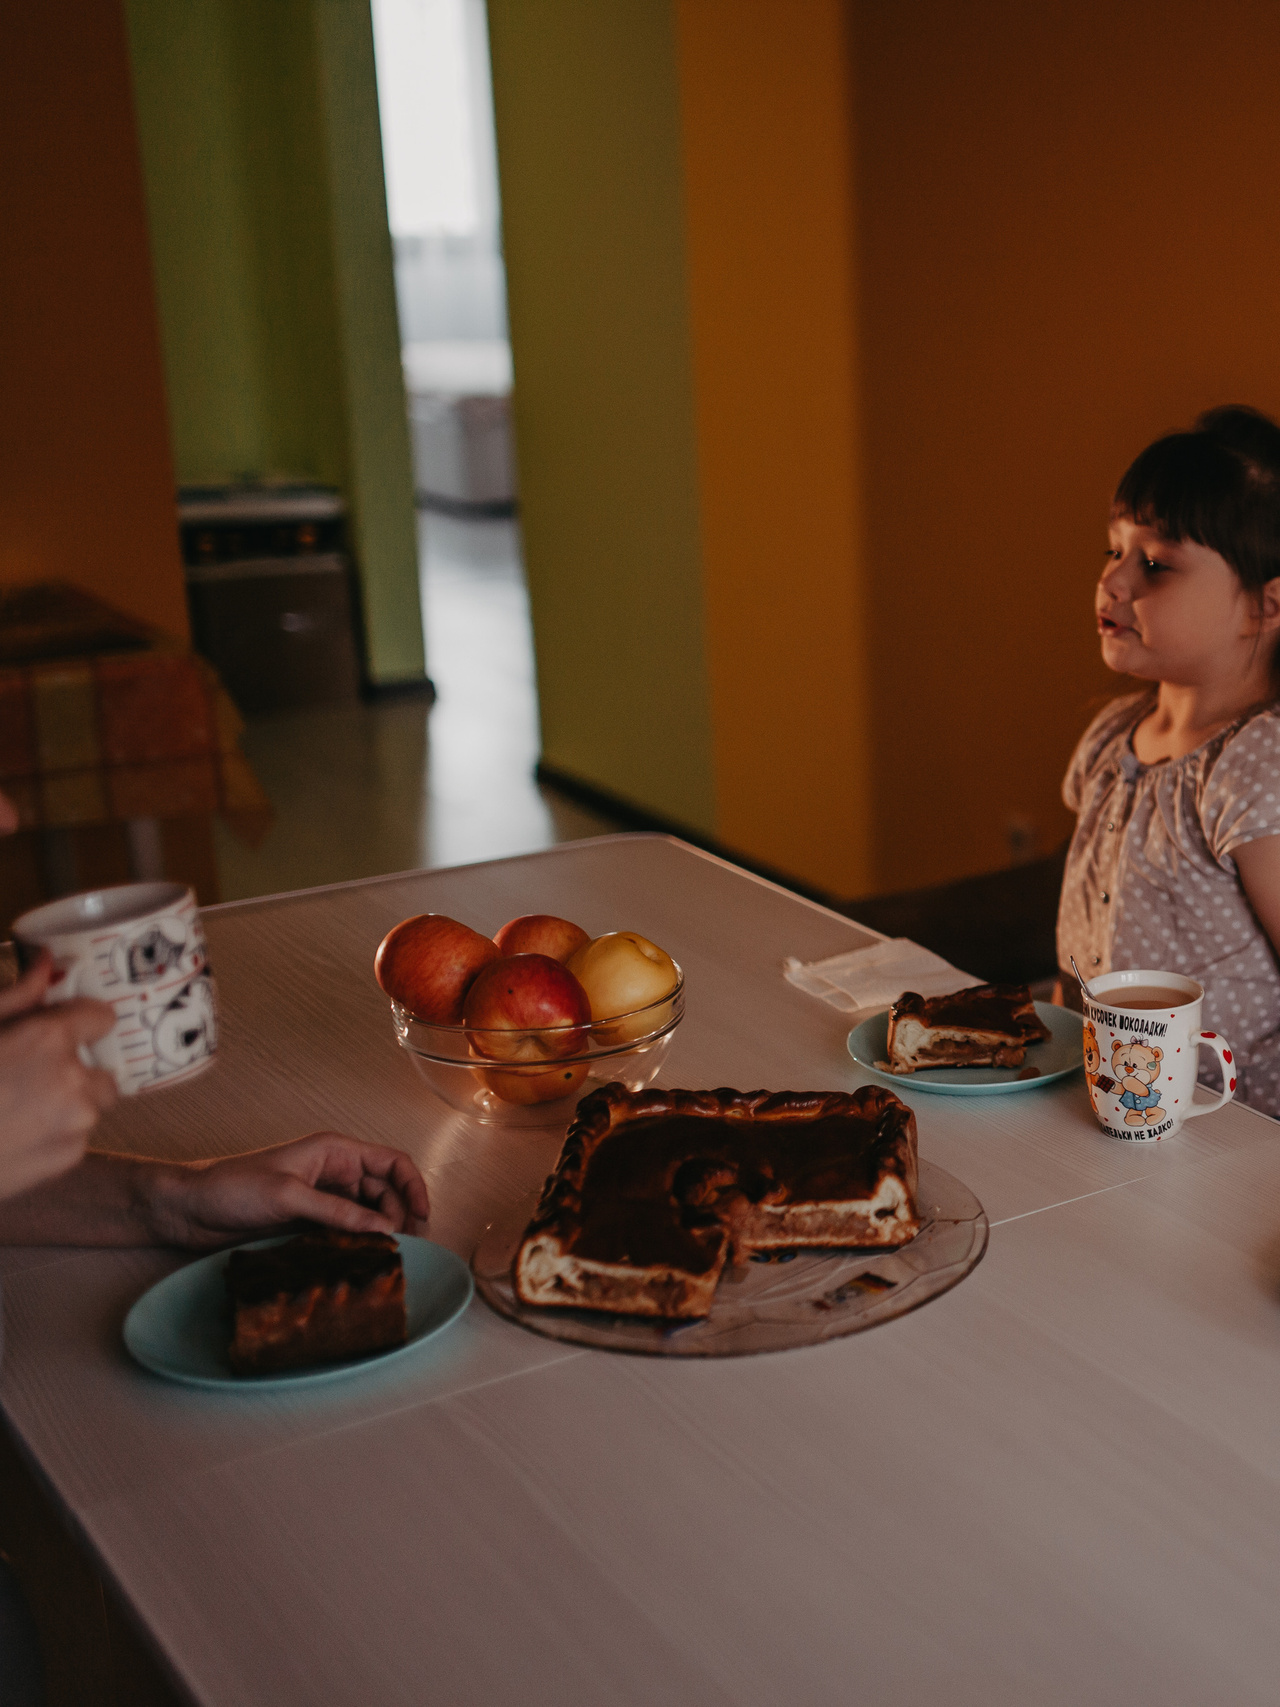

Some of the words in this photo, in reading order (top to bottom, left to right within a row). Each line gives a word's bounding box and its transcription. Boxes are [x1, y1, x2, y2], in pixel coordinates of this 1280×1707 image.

[1119, 1014, 1168, 1037] ШОКОЛАДКИ!
[1134, 1130, 1146, 1141] НЕ
[1147, 1118, 1174, 1139] ЖАЛКО!
